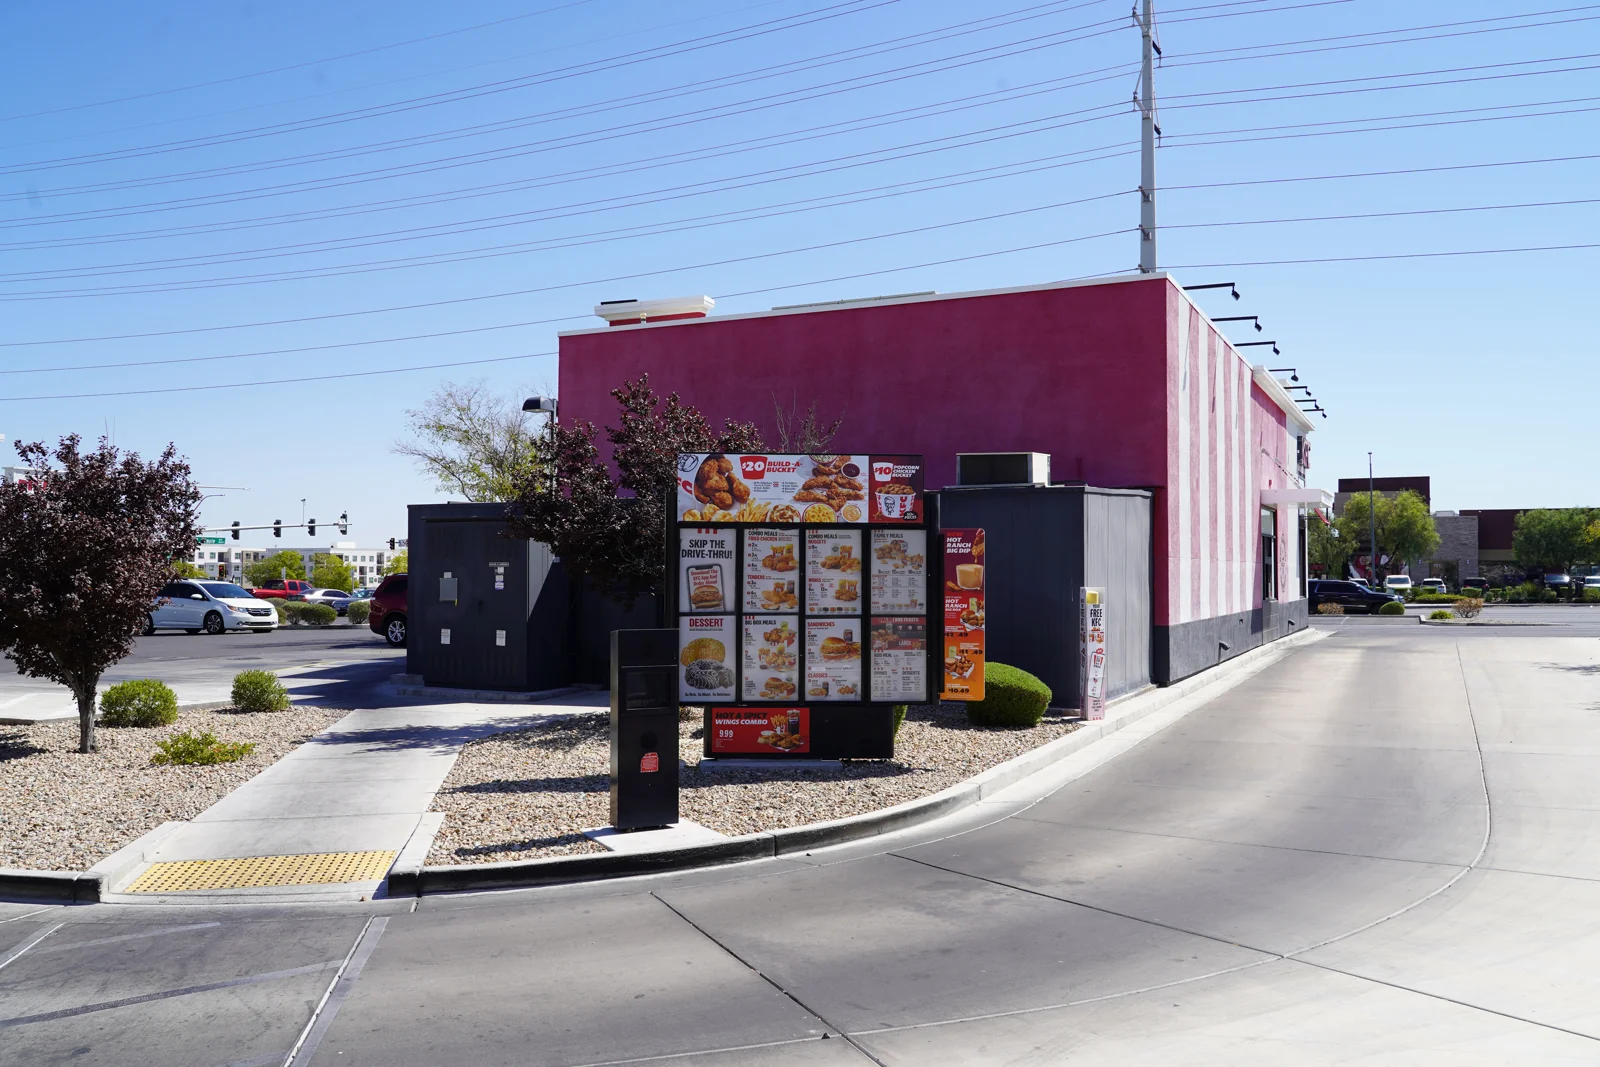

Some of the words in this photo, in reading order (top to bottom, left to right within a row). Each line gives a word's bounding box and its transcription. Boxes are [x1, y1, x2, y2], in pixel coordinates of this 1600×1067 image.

[742, 461, 765, 471] $20
[874, 466, 892, 475] $10
[689, 539, 708, 548] SKIP
[710, 540, 726, 549] THE
[681, 549, 733, 559] DRIVE-THRU!
[1090, 608, 1103, 618] FREE
[689, 618, 724, 627] DESSERT
[1091, 618, 1102, 627] KFC
[719, 729, 734, 738] 9.99
